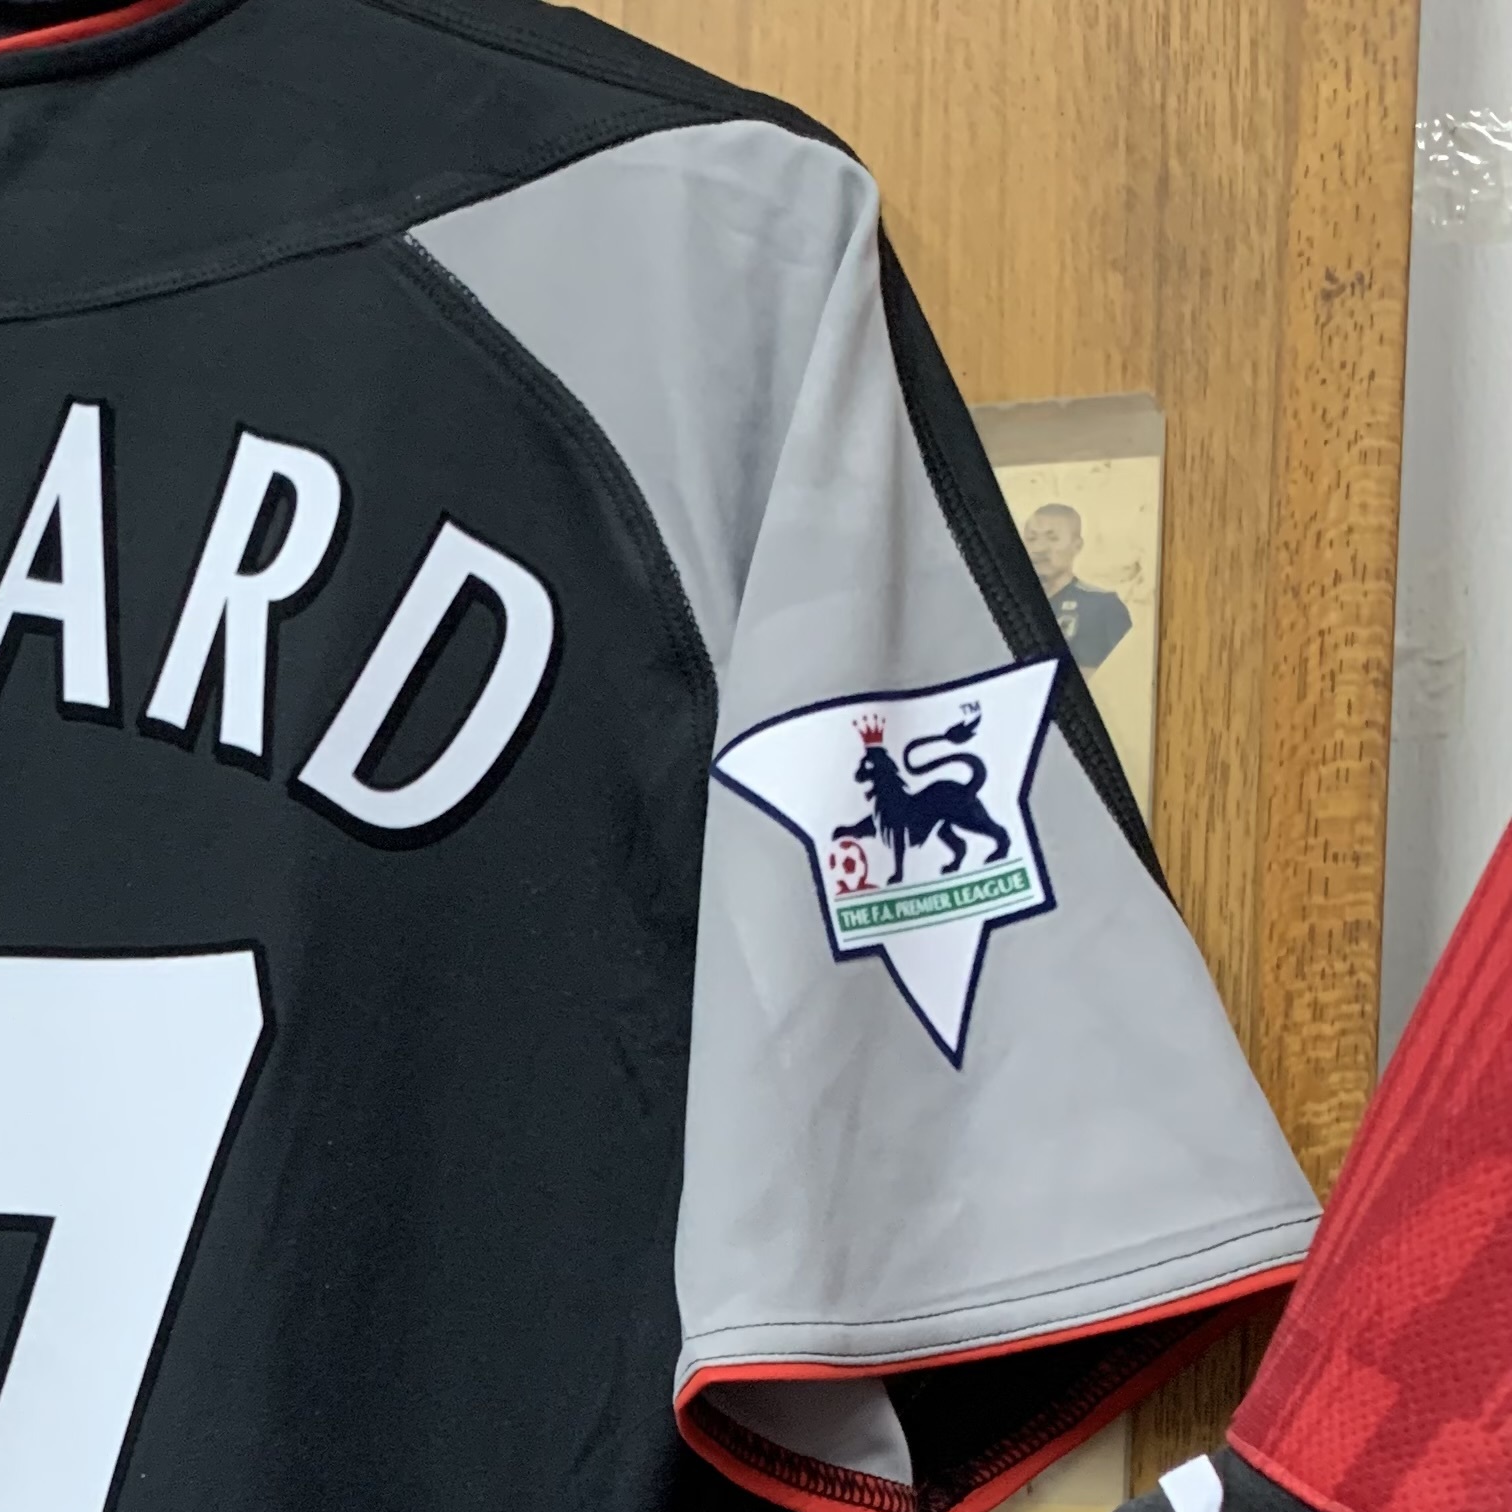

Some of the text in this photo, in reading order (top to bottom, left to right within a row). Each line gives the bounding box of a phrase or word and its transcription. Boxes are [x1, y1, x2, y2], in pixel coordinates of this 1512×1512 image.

[959, 701, 981, 716] TM
[840, 872, 1026, 928] THE F.A. PREMIER LEAGUE
